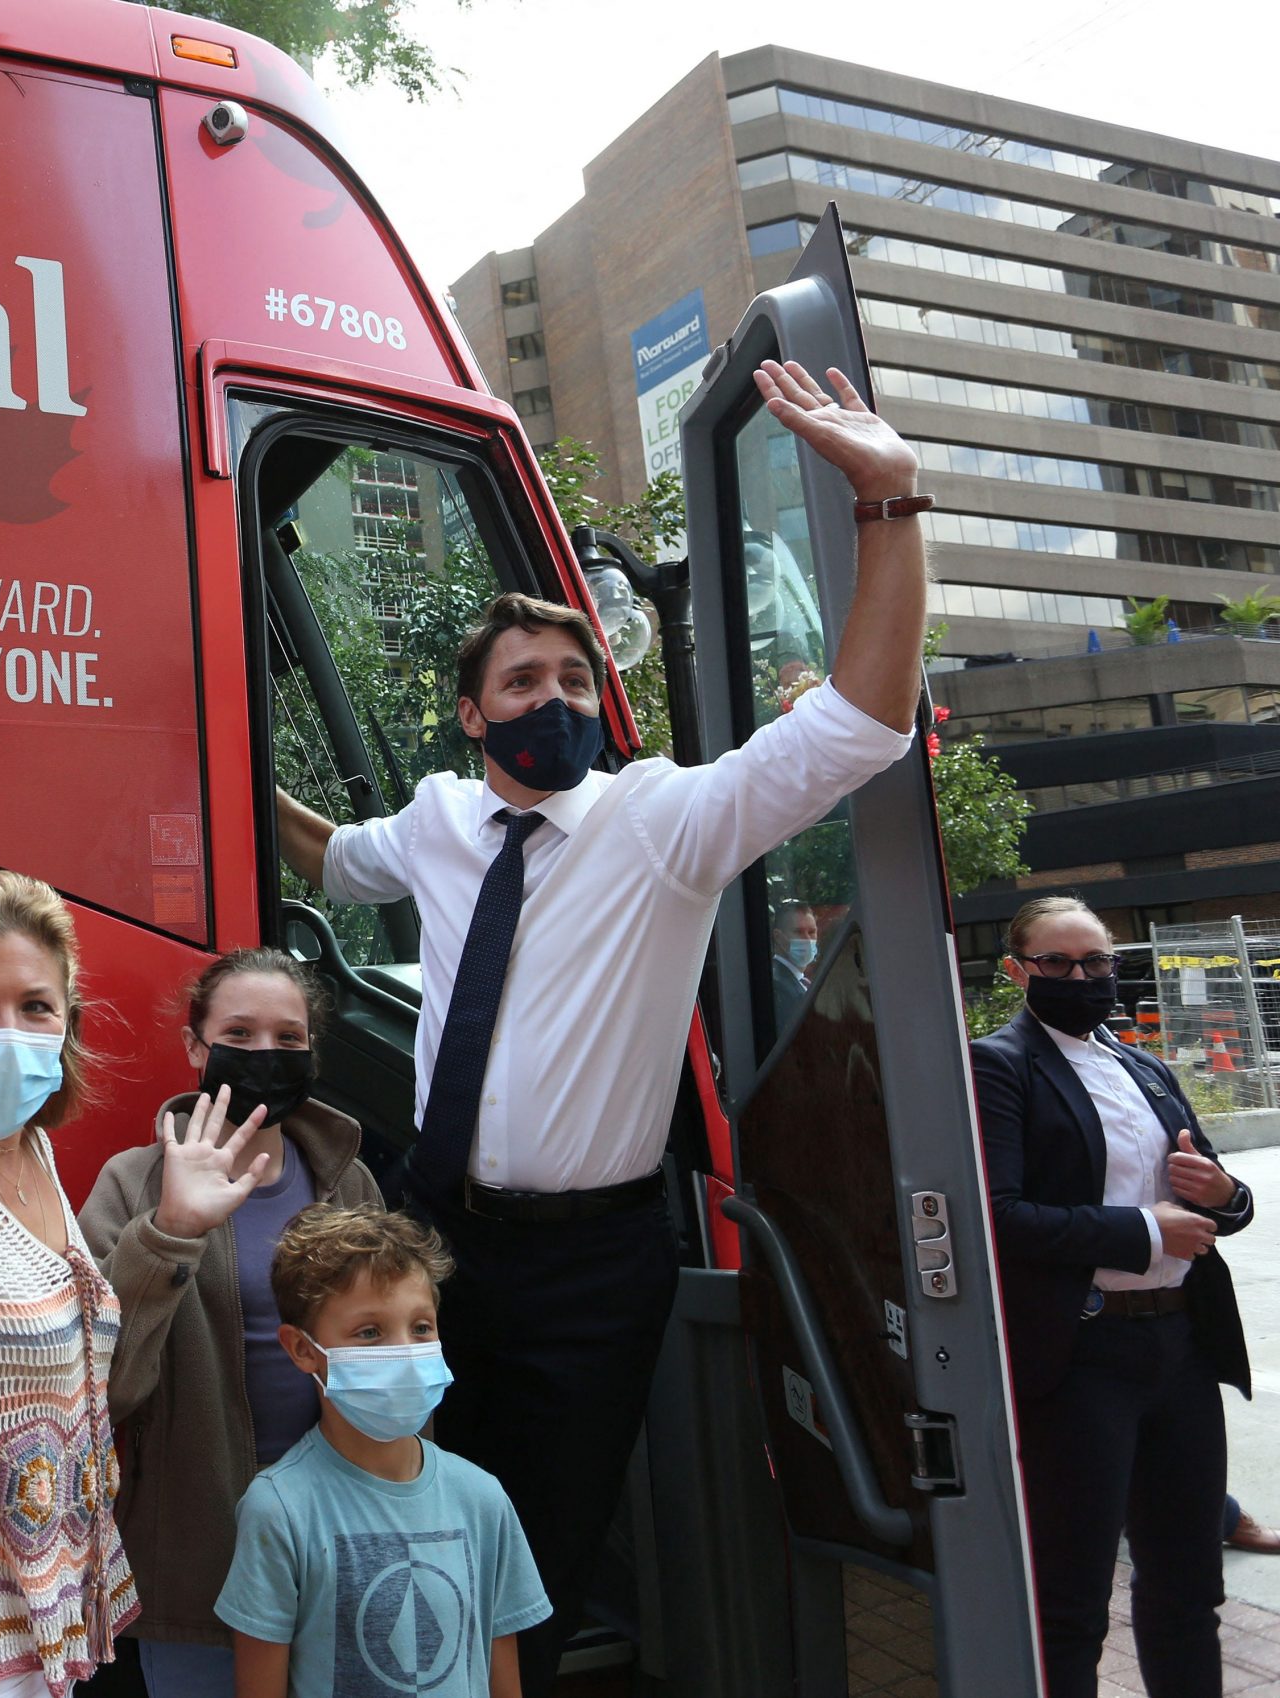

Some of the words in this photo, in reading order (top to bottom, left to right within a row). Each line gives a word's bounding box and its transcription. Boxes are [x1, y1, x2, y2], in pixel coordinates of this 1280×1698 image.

[264, 287, 408, 351] #67808
[656, 379, 694, 418] FOR
[647, 412, 680, 447] LEA
[650, 440, 682, 471] OFF
